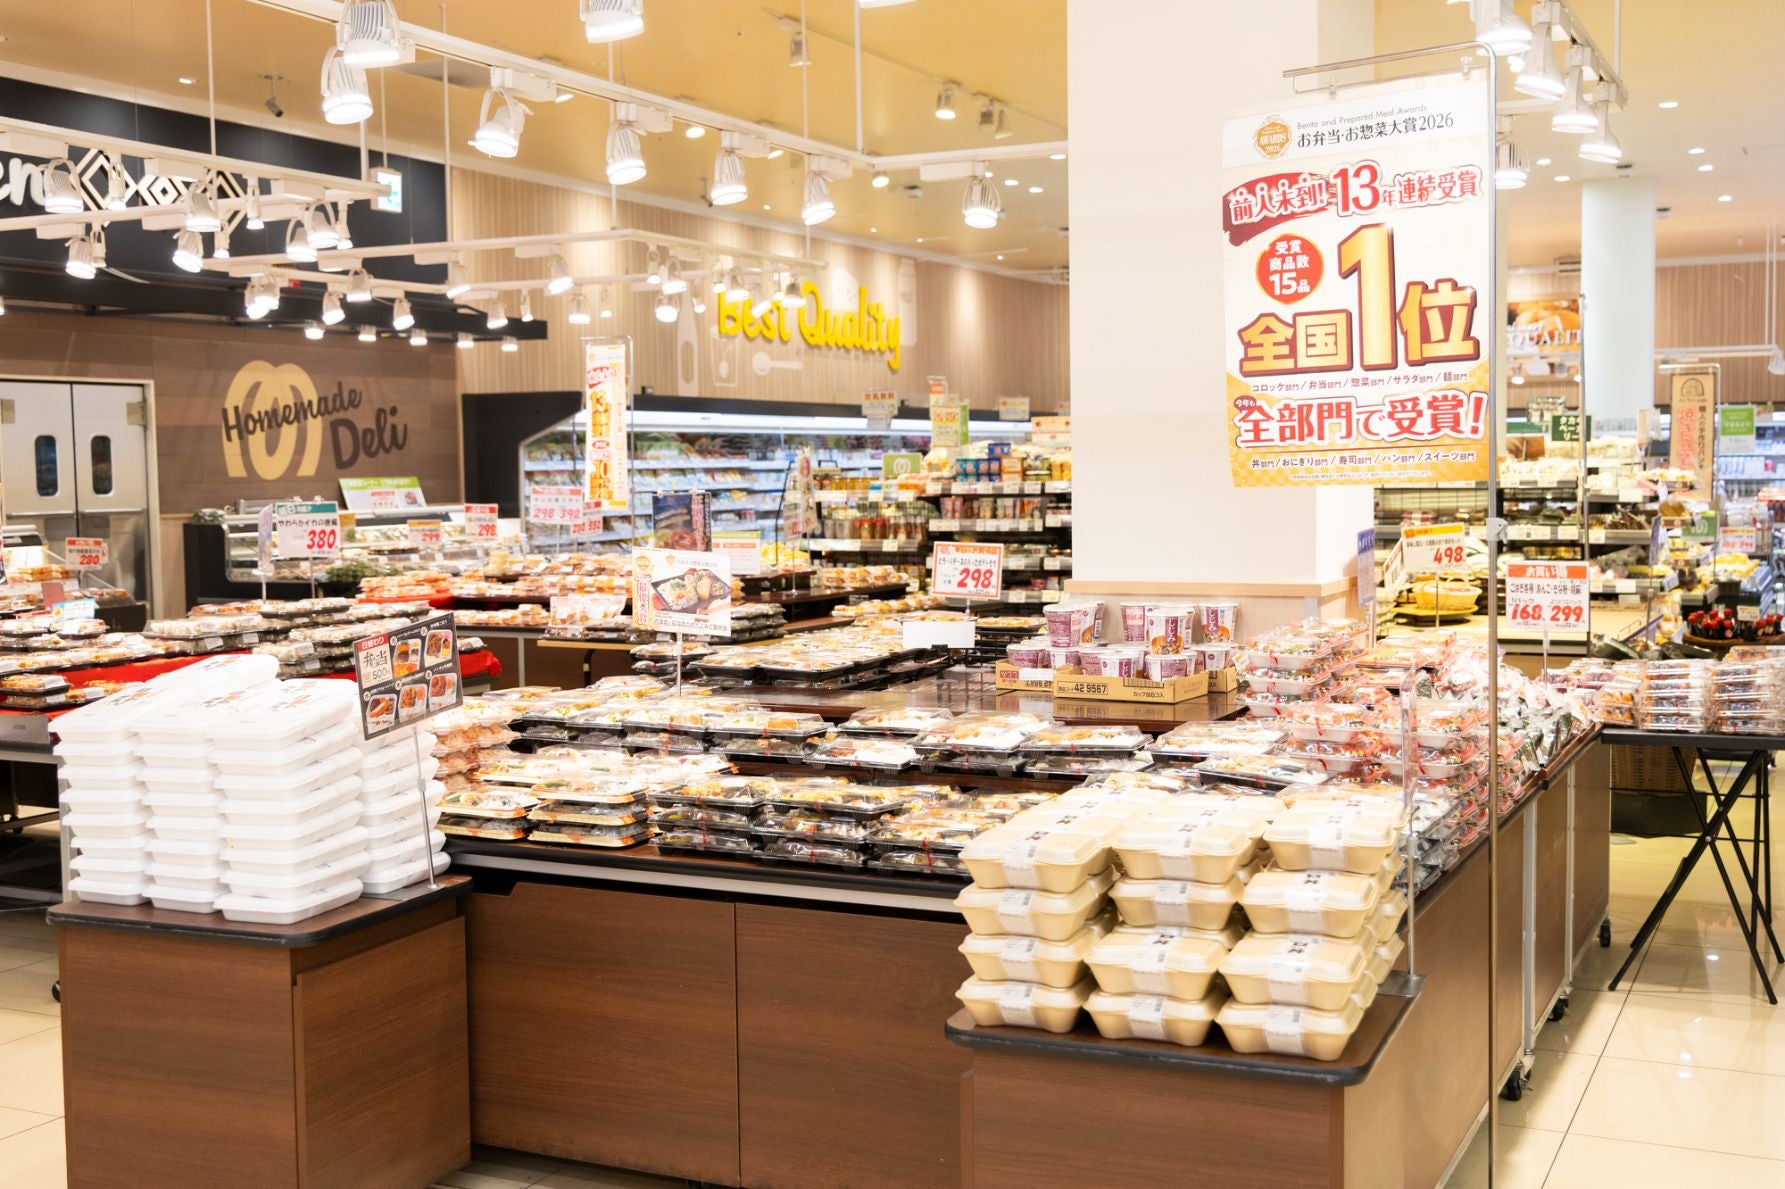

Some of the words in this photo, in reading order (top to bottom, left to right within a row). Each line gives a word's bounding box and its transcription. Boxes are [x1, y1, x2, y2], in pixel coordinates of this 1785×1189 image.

[1297, 122, 1318, 130] Bento
[1339, 113, 1373, 126] Prepared
[1375, 107, 1394, 118] Meal
[1397, 104, 1427, 114] Awards
[1275, 240, 1303, 255] 受賞
[1269, 255, 1310, 272] 商品数
[1269, 273, 1311, 296] 15品
[1238, 223, 1480, 378] 全国1位
[718, 288, 792, 342] Best
[798, 281, 900, 372] Quality
[221, 381, 362, 443] Homemade
[329, 405, 407, 469] Deli
[533, 508, 554, 518] 298
[559, 508, 580, 519] 398
[306, 529, 336, 550] 380
[478, 524, 497, 537] 298
[80, 555, 99, 565] 280
[1434, 546, 1463, 564] 498
[957, 567, 994, 589] 298
[1526, 566, 1567, 578] お買い得
[1512, 604, 1543, 620] 168
[1550, 605, 1583, 622] 299
[1168, 619, 1176, 642] しじみ
[363, 650, 387, 668] 弁当
[1074, 683, 1084, 692] 42
[1086, 684, 1107, 694] 9567
